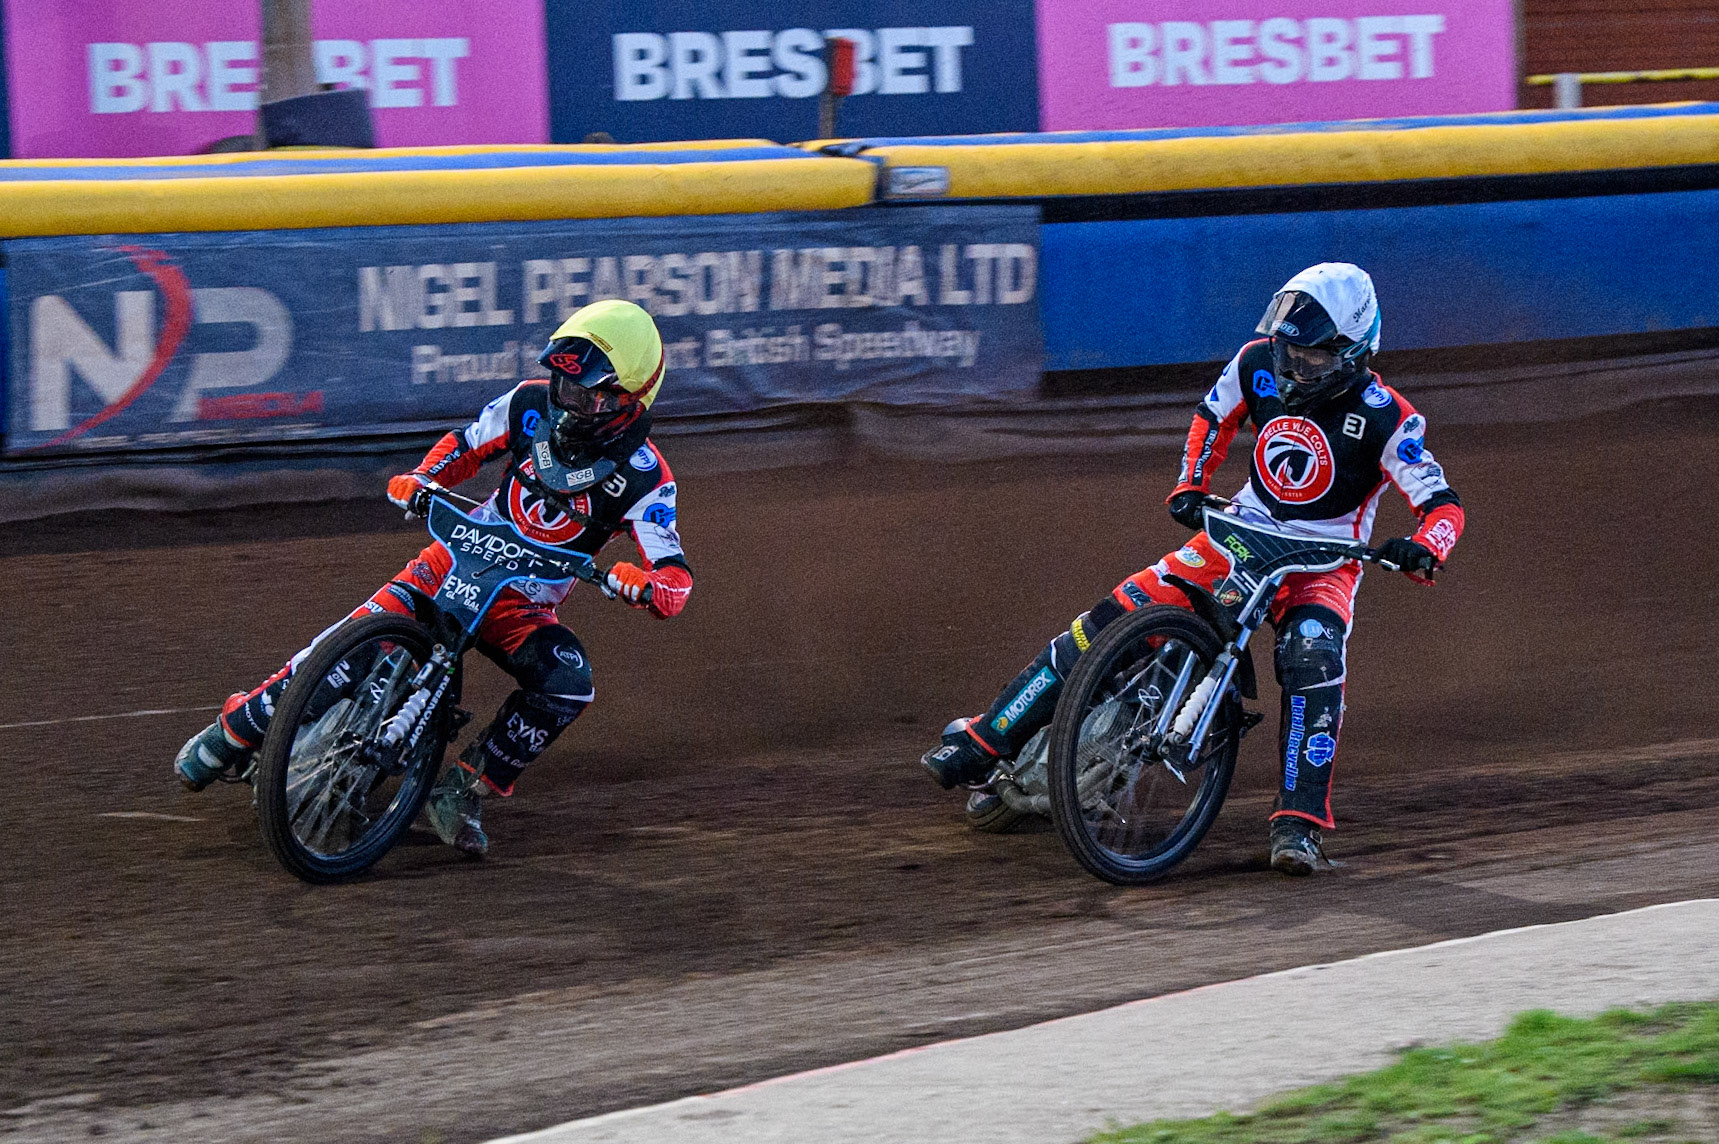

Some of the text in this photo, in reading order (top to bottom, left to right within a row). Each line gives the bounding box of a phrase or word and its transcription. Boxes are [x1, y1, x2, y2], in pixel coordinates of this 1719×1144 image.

[1107, 14, 1446, 88] BRESBET
[87, 38, 469, 114] BREBET
[357, 243, 1036, 332] NIGEL PEARSON MEDIA LTD
[411, 344, 520, 385] Proud
[814, 323, 981, 371] Speedway
[540, 451, 551, 468] GB
[1264, 421, 1329, 467] BELLE VUE COLTS
[576, 469, 593, 480] GB
[460, 542, 519, 571] SPEED
[1004, 671, 1052, 722] MOTOREX
